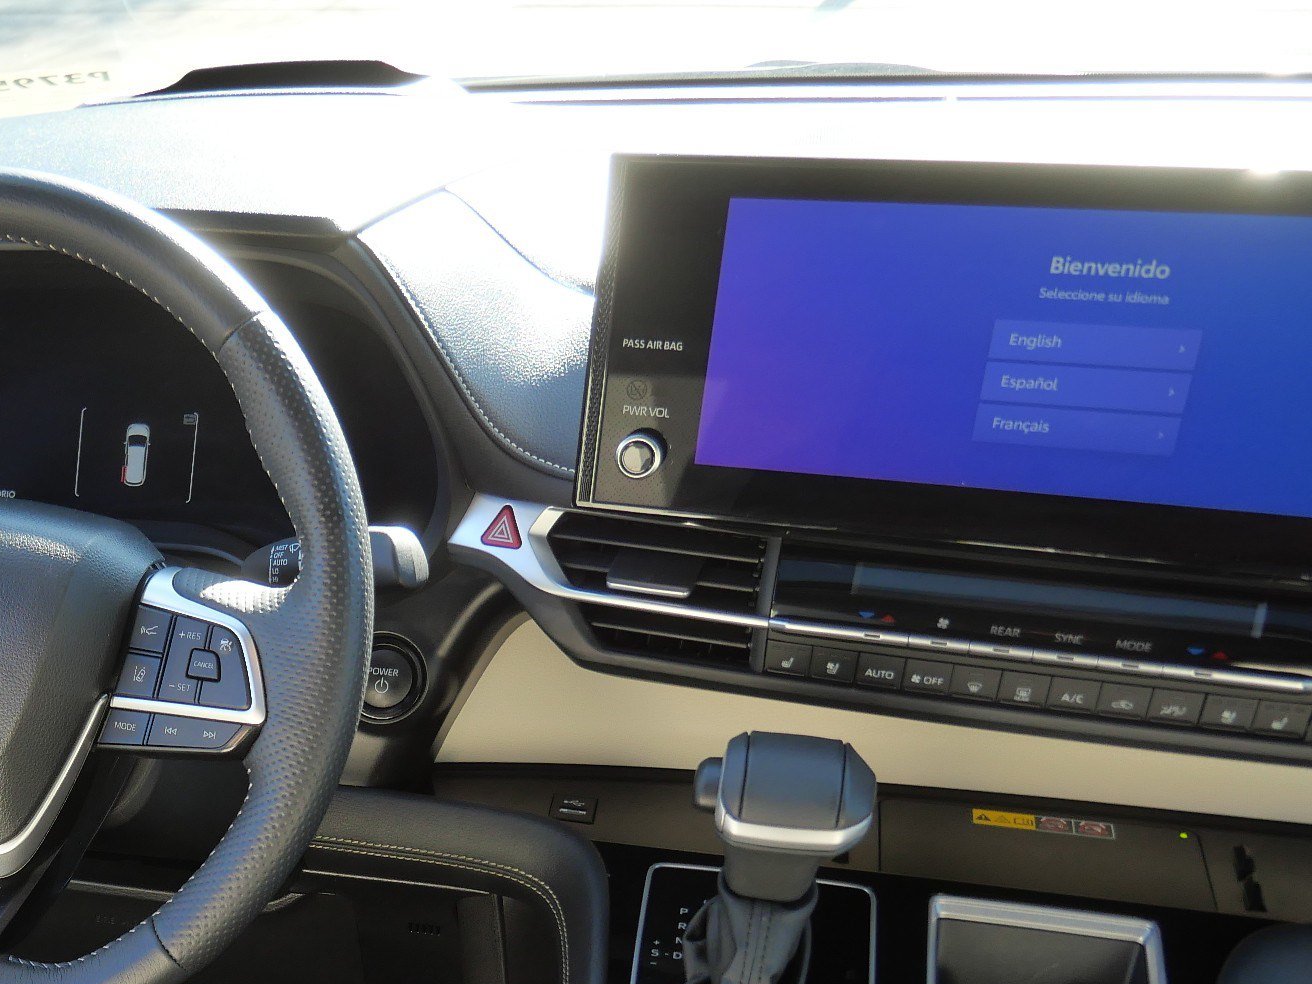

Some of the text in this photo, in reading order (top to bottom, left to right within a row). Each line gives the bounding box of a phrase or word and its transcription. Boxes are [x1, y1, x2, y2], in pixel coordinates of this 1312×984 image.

[1049, 255, 1171, 280] Bienvenido
[1039, 287, 1170, 305] Seleccione su idioma
[622, 338, 683, 352] PASS AIR BAG
[1008, 332, 1063, 351] English
[1000, 374, 1059, 391] Español
[622, 404, 670, 419] PWR VOL
[992, 416, 1050, 434] Français
[990, 625, 1021, 638] REAR
[1054, 632, 1085, 645] SYNC
[1115, 639, 1153, 652] MODE
[193, 660, 214, 670] CANCEL
[368, 667, 399, 677] POWER
[864, 668, 895, 680] AUTO
[923, 676, 944, 686] OFF
[1060, 692, 1085, 705] A/C
[114, 721, 137, 732] MODE
[679, 907, 689, 915] P
[677, 922, 687, 930] R
[650, 949, 683, 960] S D
